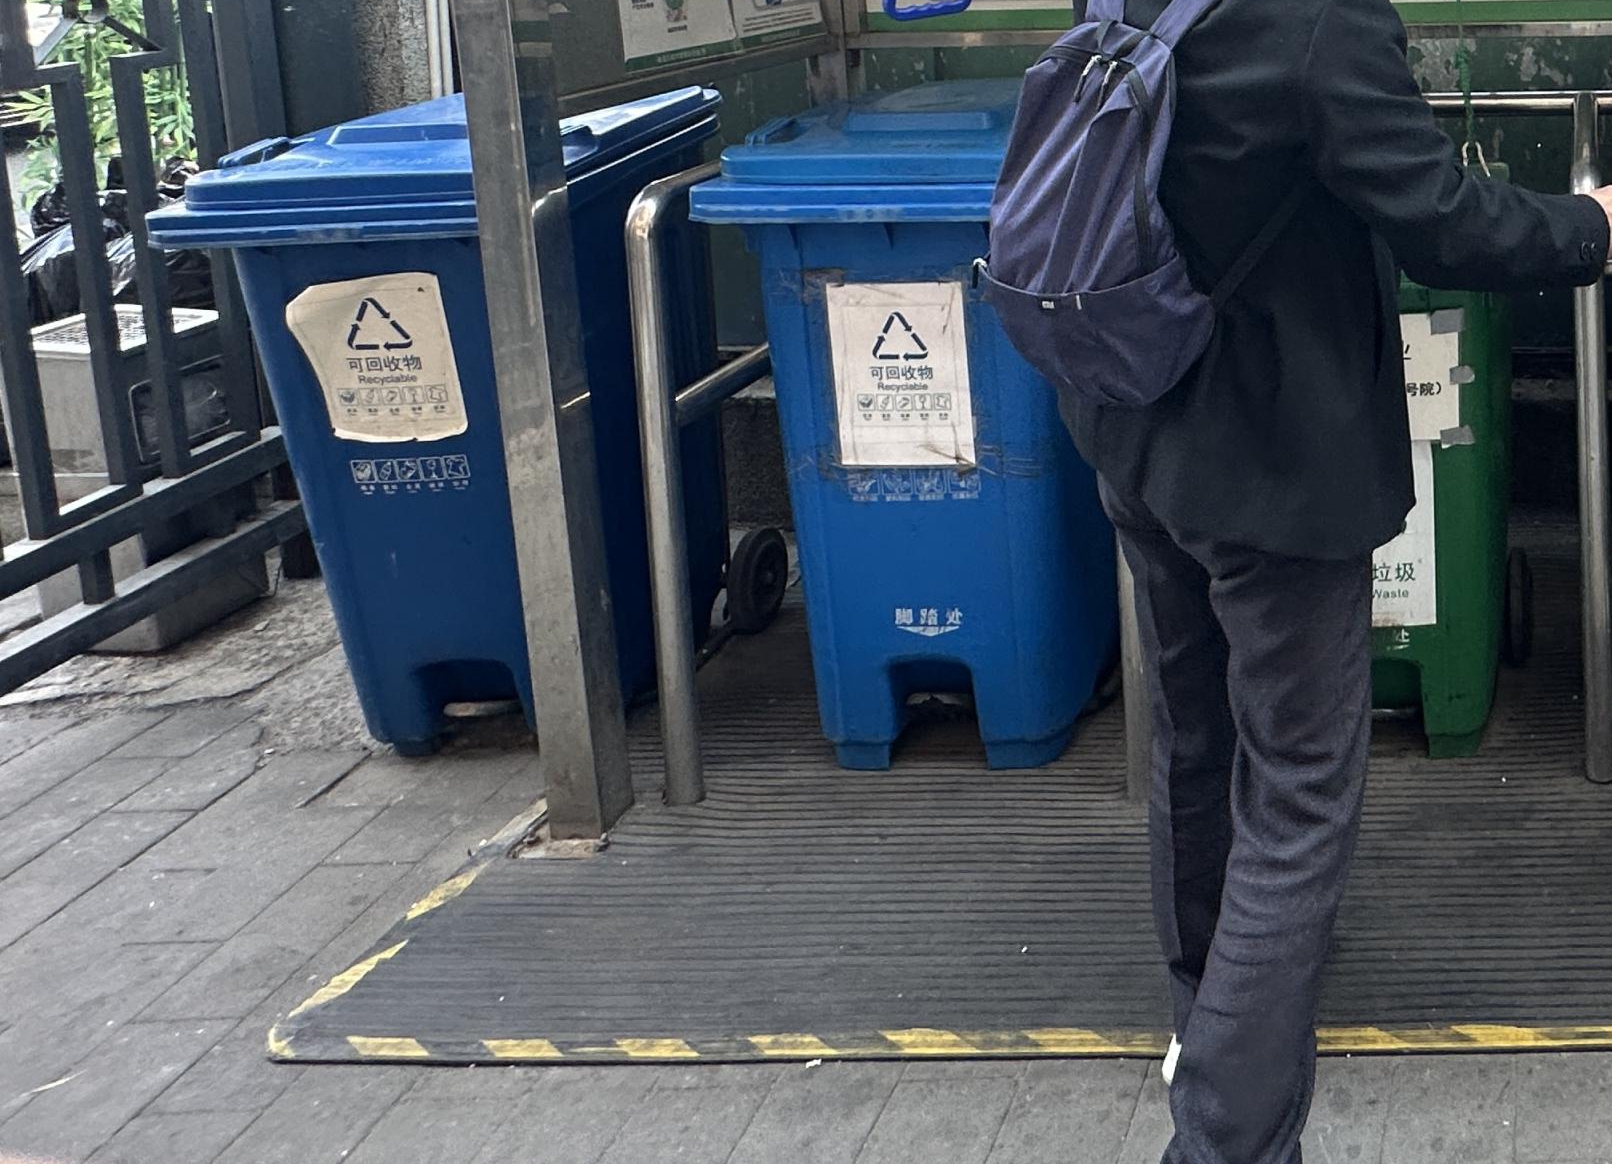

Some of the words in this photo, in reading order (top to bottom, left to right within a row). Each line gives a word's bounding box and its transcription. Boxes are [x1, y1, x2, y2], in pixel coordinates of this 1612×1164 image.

[346, 355, 422, 372] 可回收物
[358, 374, 418, 385] Recyclable
[869, 365, 933, 380] 可回收物
[877, 382, 928, 392] Recyclable
[1372, 562, 1416, 582] 垃圾
[895, 607, 963, 625] 脚踏处
